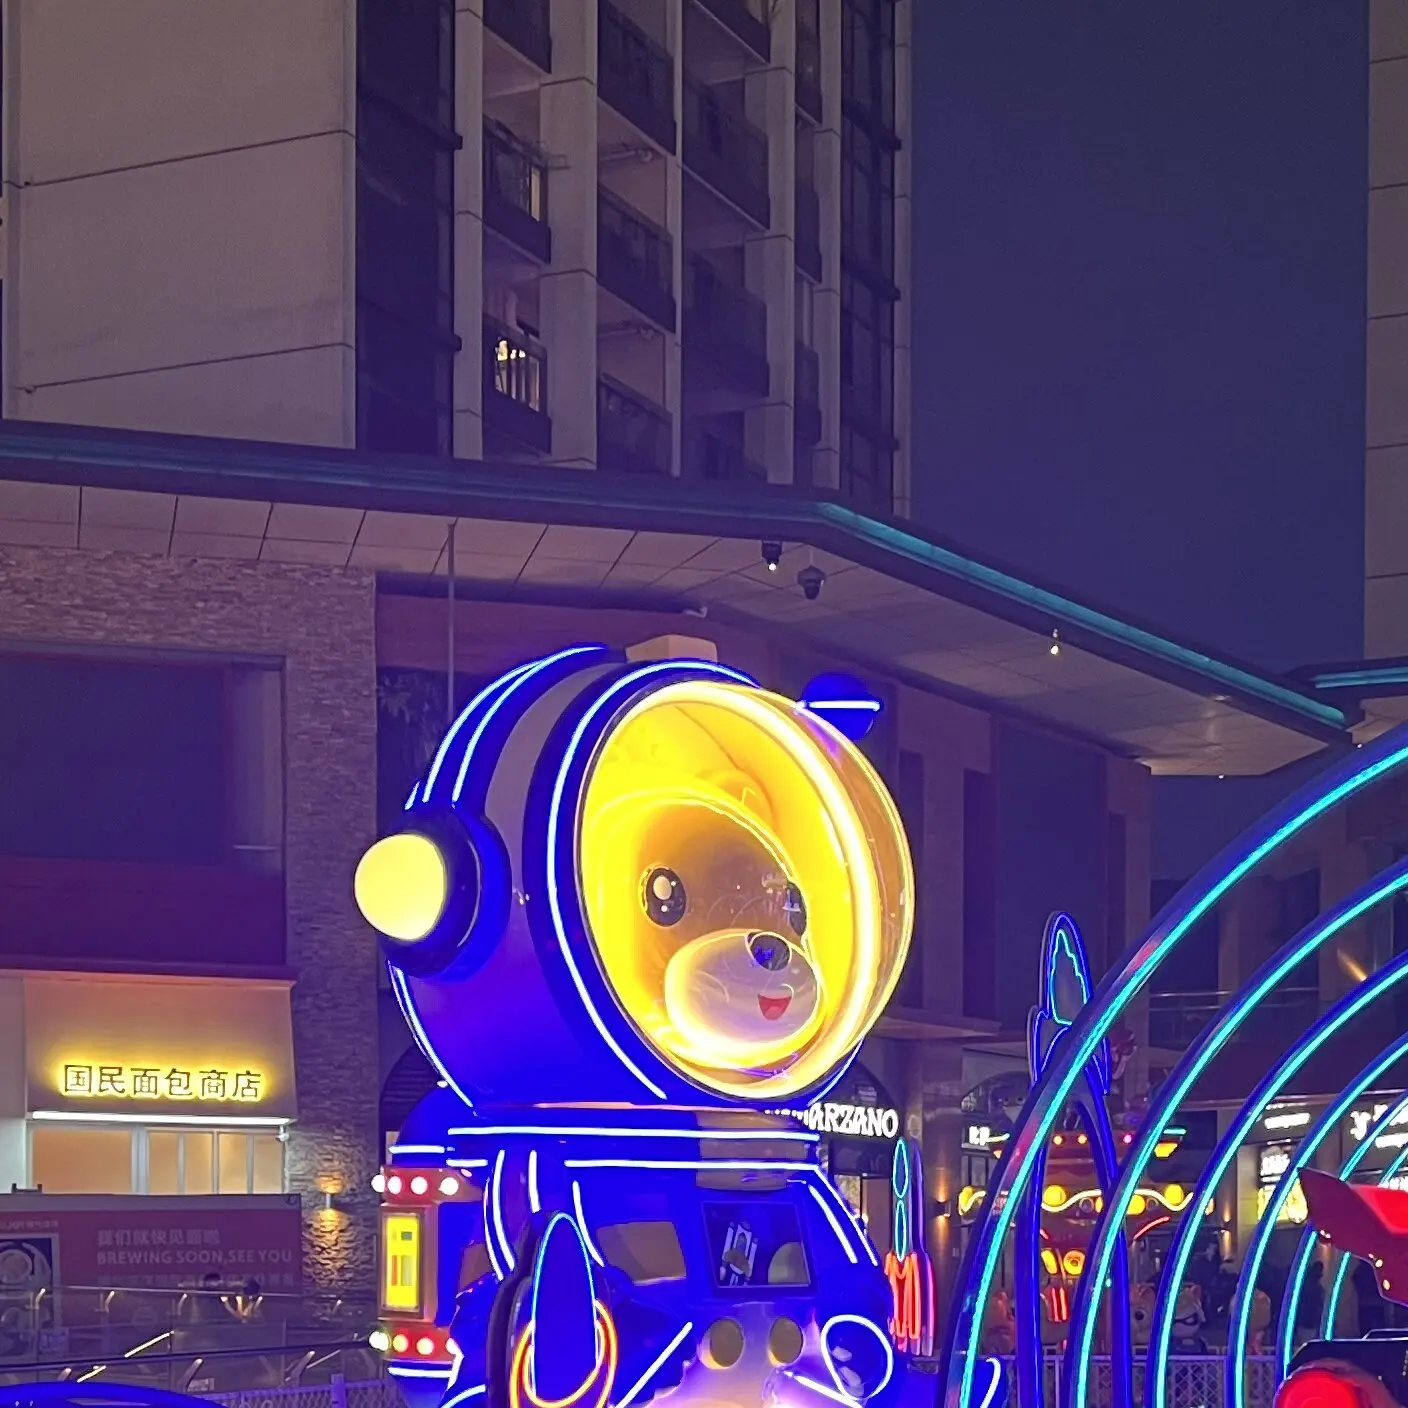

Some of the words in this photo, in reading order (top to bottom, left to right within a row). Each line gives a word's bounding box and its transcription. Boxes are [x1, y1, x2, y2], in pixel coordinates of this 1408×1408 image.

[63, 1064, 262, 1099] 国民面包商店
[97, 1250, 172, 1266] BREWING
[259, 1249, 293, 1265] YOU
